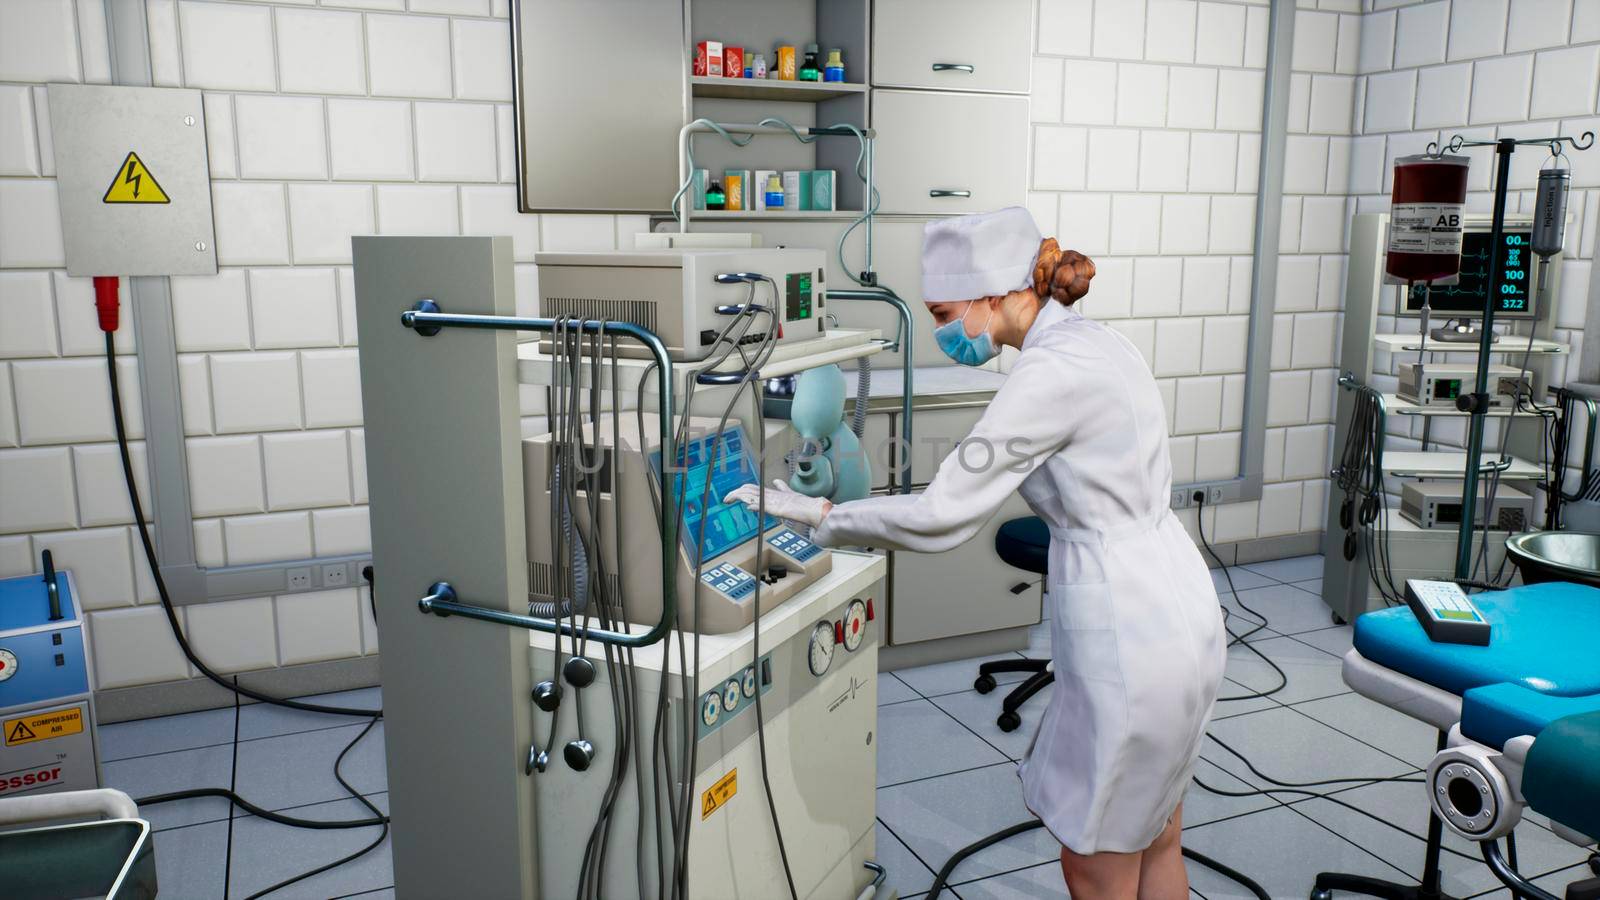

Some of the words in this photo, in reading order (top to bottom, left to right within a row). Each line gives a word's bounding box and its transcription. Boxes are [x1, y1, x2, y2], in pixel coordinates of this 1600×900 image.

[1436, 214, 1460, 227] AB
[1506, 235, 1521, 245] 00
[1505, 270, 1525, 280] 100
[1501, 285, 1516, 294] 00
[1503, 299, 1524, 308] 37.2
[31, 713, 79, 727] COMPRESSED
[51, 725, 63, 733] AIR
[0, 767, 62, 791] essor
